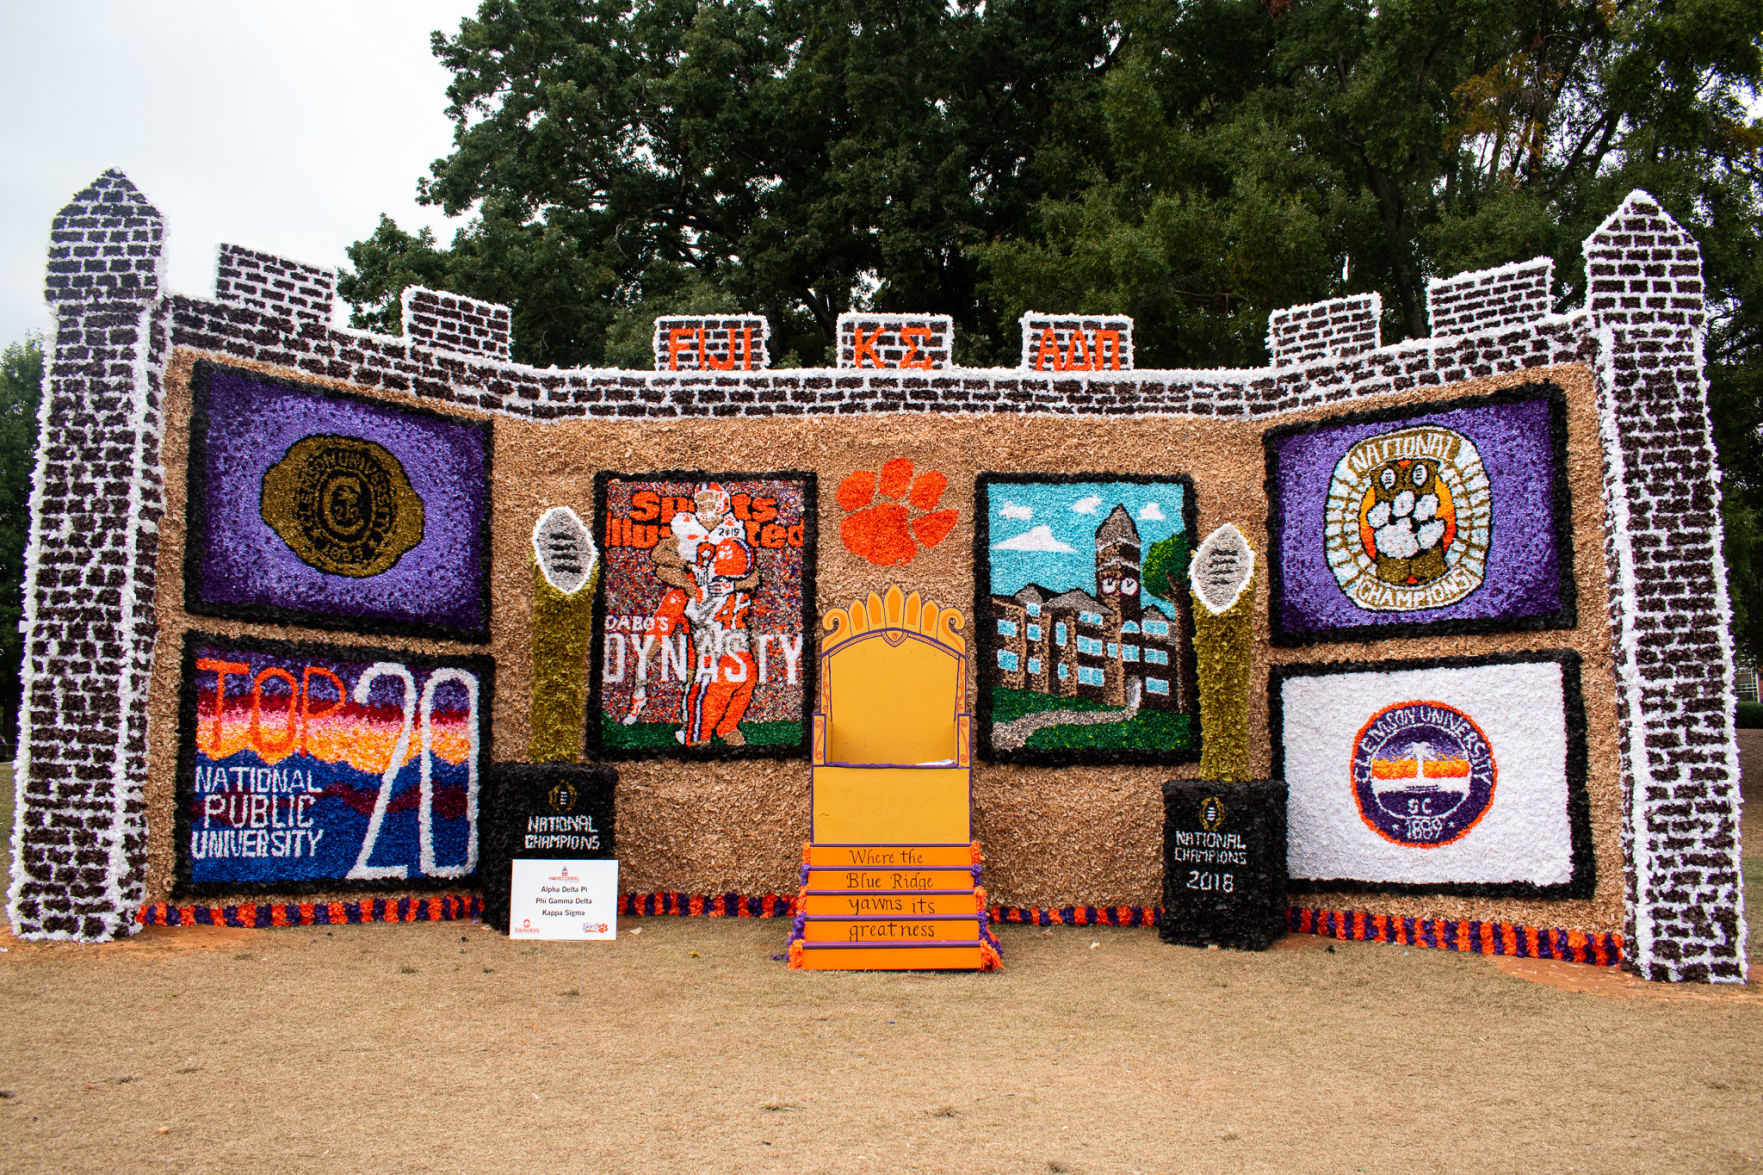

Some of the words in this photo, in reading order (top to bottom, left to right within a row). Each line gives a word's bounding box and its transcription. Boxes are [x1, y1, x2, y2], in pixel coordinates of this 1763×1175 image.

[668, 327, 752, 371] FIJI
[1351, 433, 1456, 473] NATIONAL
[1357, 566, 1472, 608] CHAMPIONS
[603, 632, 805, 685] DYNASTY
[1354, 707, 1416, 784] CLEMSON
[1420, 706, 1493, 785] UNIVERSITY
[196, 658, 347, 758] TOP
[345, 661, 480, 880] 20
[194, 766, 323, 793] NATIONAL
[204, 794, 317, 829] PUBLIC
[527, 815, 599, 833] NATIONAL
[1405, 818, 1443, 839] 1889
[190, 828, 324, 859] UNIVERSITY
[525, 834, 601, 850] CHAMPIONS
[1175, 830, 1247, 850] NATIONAL
[849, 849, 895, 865] Where
[900, 849, 924, 865] the
[1174, 847, 1248, 865] CHAMPIONS
[541, 886, 560, 894] Alpha
[846, 872, 882, 889] Blue
[890, 872, 934, 891] Ridge
[1186, 870, 1234, 893] 2018
[535, 897, 547, 905] Phi
[548, 897, 573, 905] Gamma
[575, 897, 593, 905] Delta
[848, 895, 903, 915] yawns
[912, 897, 935, 914] its
[542, 909, 563, 918] Kappa
[565, 909, 586, 918] Sigma
[849, 922, 935, 942] greatness
